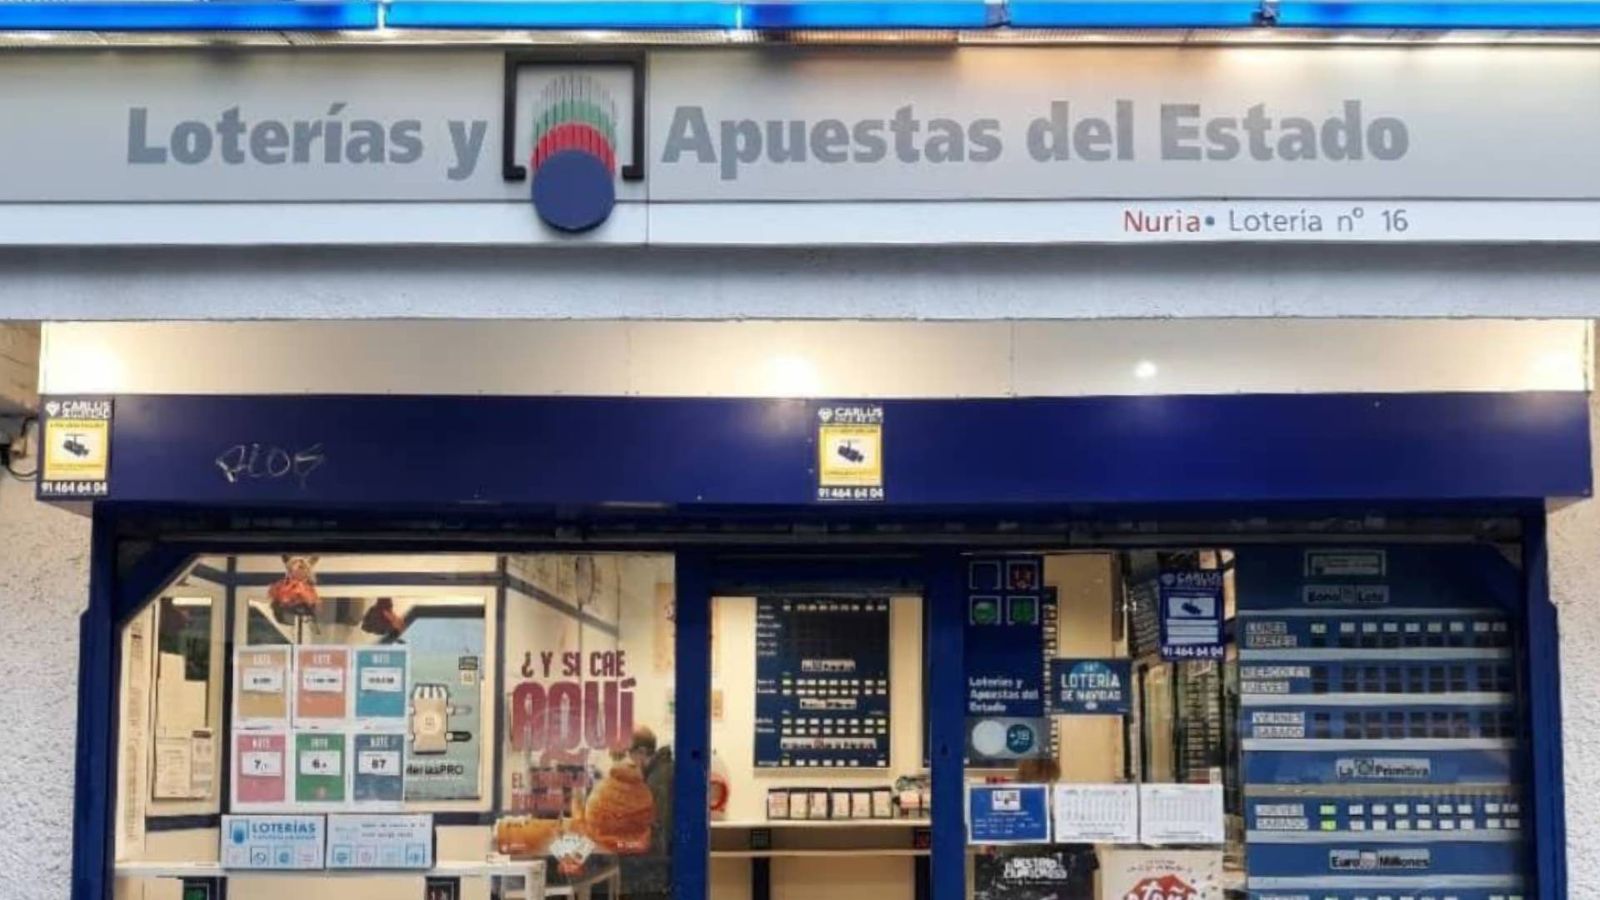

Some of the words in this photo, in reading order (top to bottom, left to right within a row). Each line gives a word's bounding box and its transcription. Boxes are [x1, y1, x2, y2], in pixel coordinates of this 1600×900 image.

[127, 102, 424, 165] Loterías
[447, 120, 488, 181] y
[661, 104, 1003, 180] Apuestas
[1026, 100, 1134, 162] del
[1161, 100, 1409, 162] Estado
[1124, 209, 1201, 233] Nuria
[1385, 209, 1408, 232] 16
[41, 482, 53, 493] 91
[55, 482, 75, 493] 464
[77, 482, 91, 493] 64
[818, 488, 829, 498] 91
[831, 488, 851, 498] 464
[854, 488, 868, 498] 64
[562, 652, 580, 677] SI
[590, 650, 626, 677] CAE
[1061, 670, 1121, 688] LOTERÍA
[252, 820, 316, 833] LOTERÍAS
